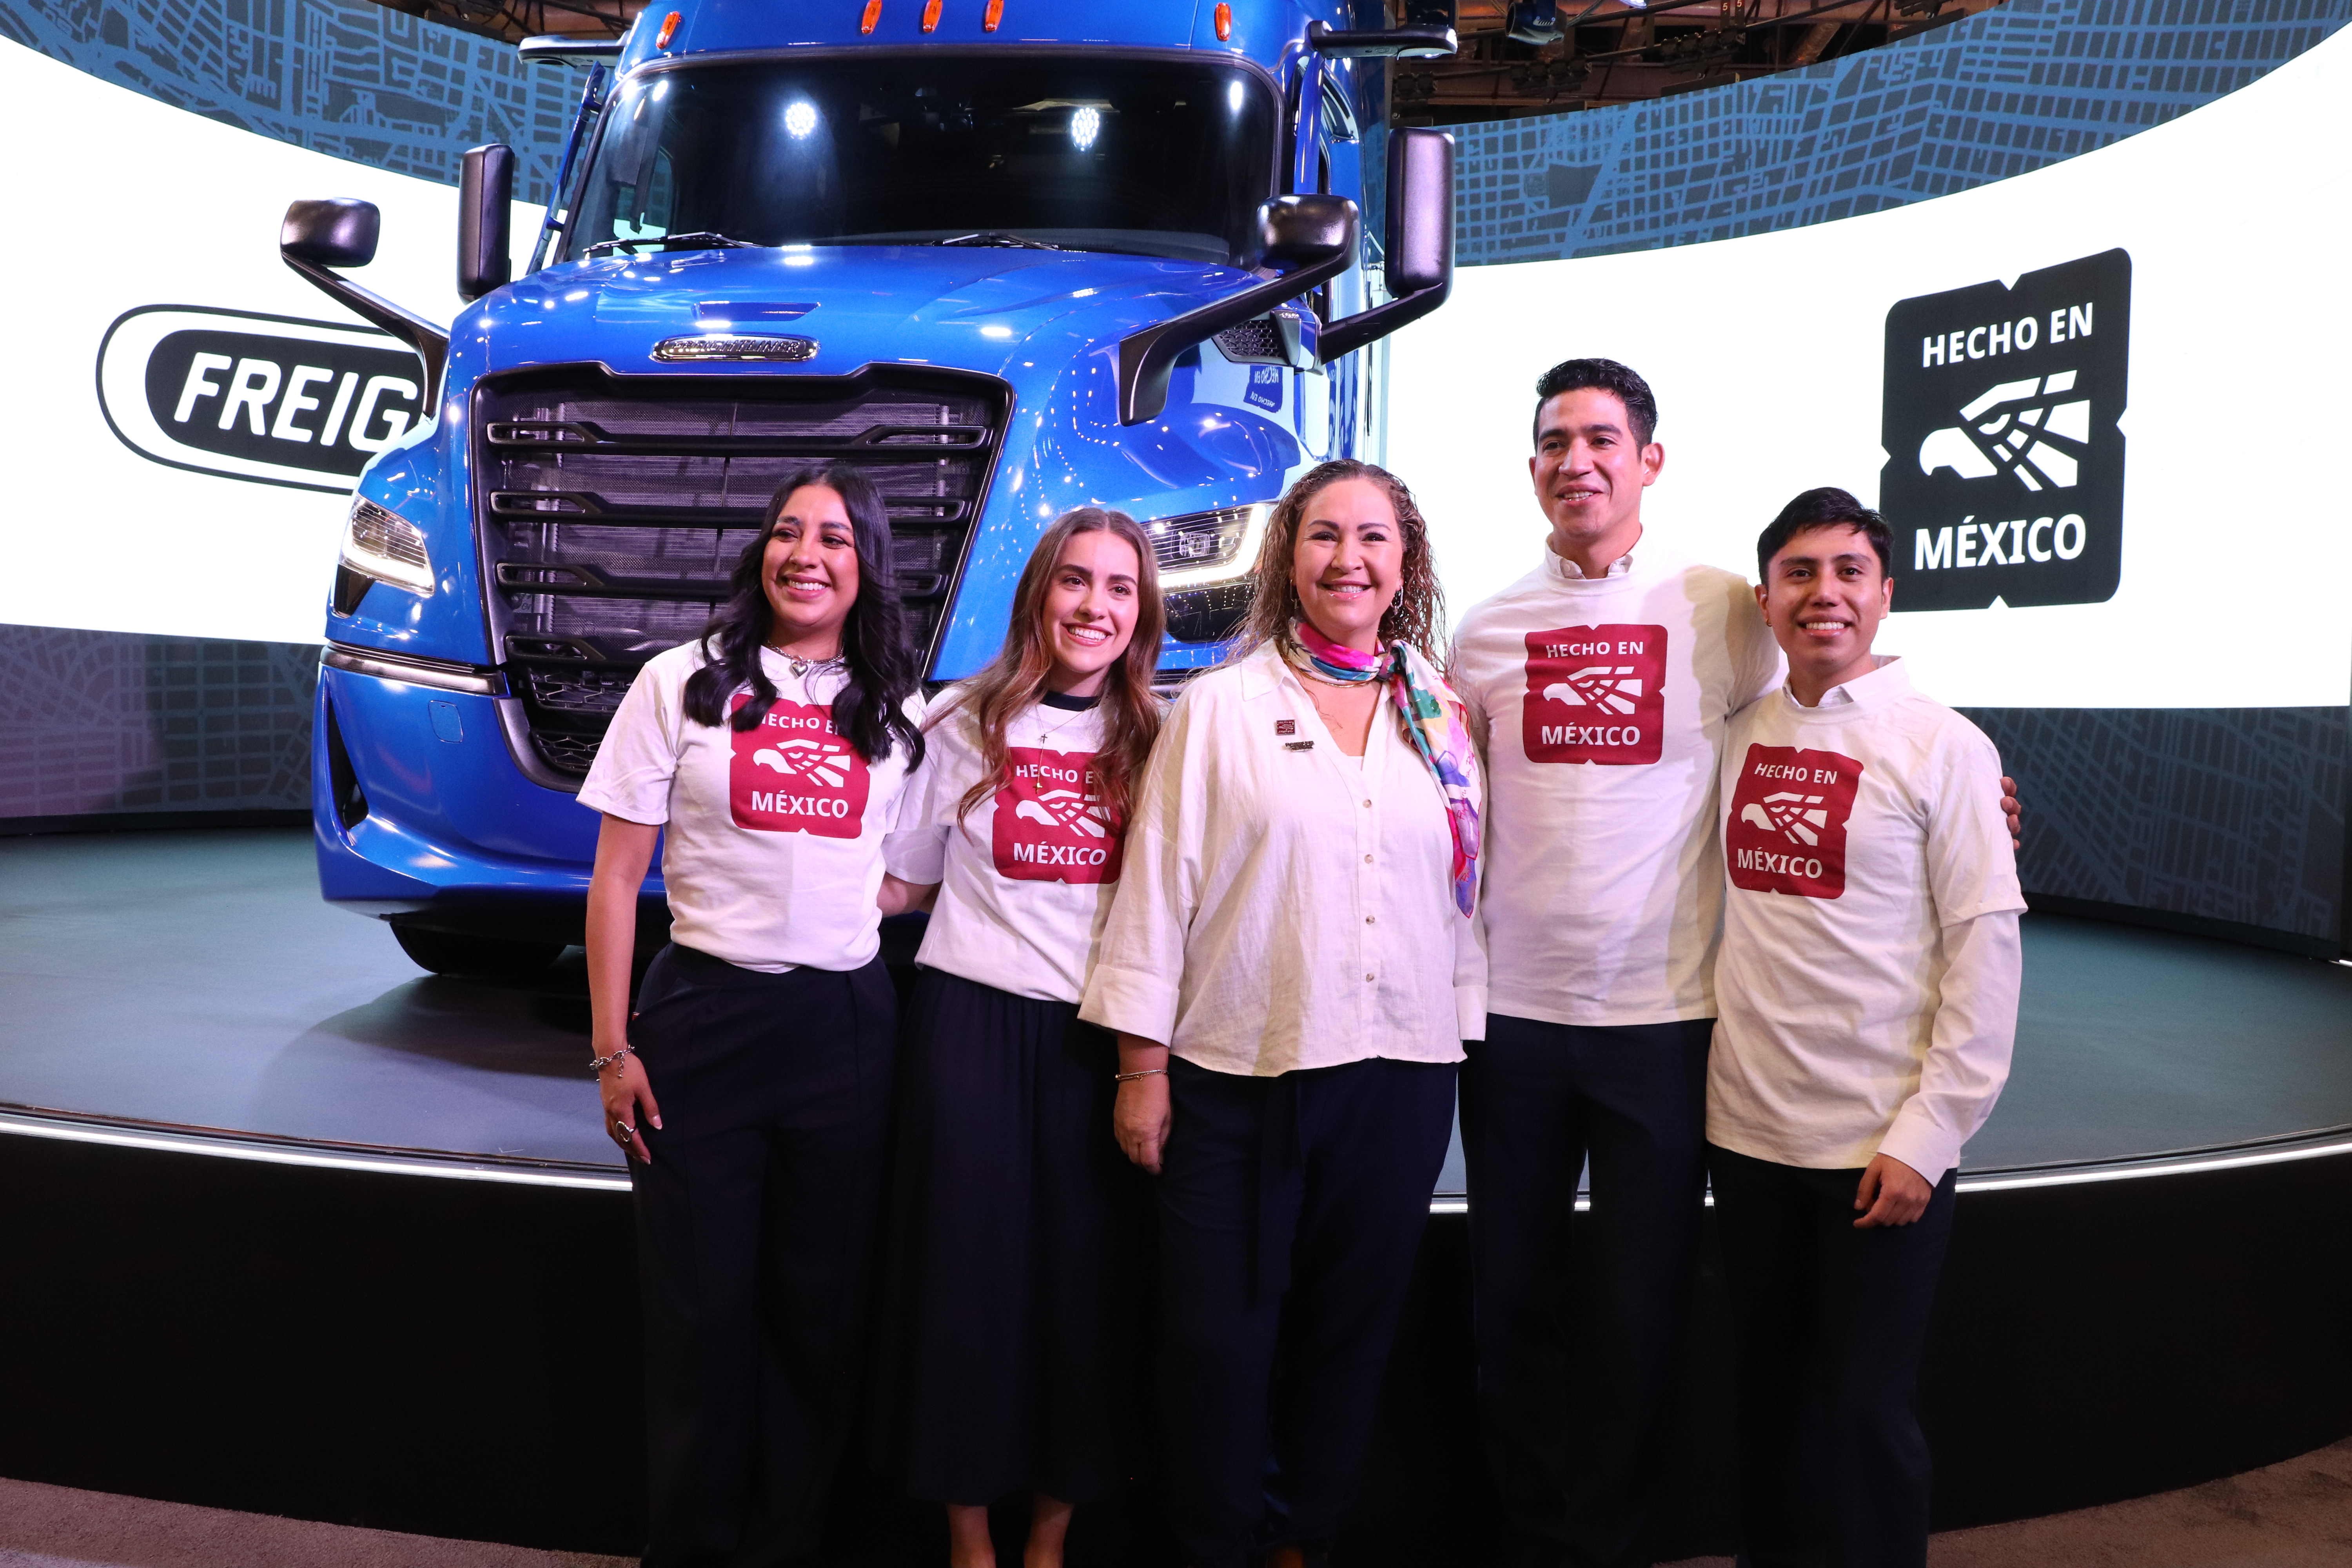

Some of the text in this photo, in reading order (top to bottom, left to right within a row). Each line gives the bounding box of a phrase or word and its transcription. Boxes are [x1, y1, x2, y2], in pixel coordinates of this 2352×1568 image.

[1923, 302, 2093, 368] HECHO EN
[1915, 514, 2086, 570] MÉXICO
[1546, 641, 1644, 658] HECHO EN
[825, 720, 838, 735] E
[1542, 722, 1641, 746] MÉXICO
[1016, 764, 1078, 783] HECHO
[1754, 763, 1838, 784] HECHO EN
[752, 790, 849, 818] MÉXICO
[1014, 841, 1106, 866] MÉXICO
[1737, 847, 1823, 879] MÉXICO
